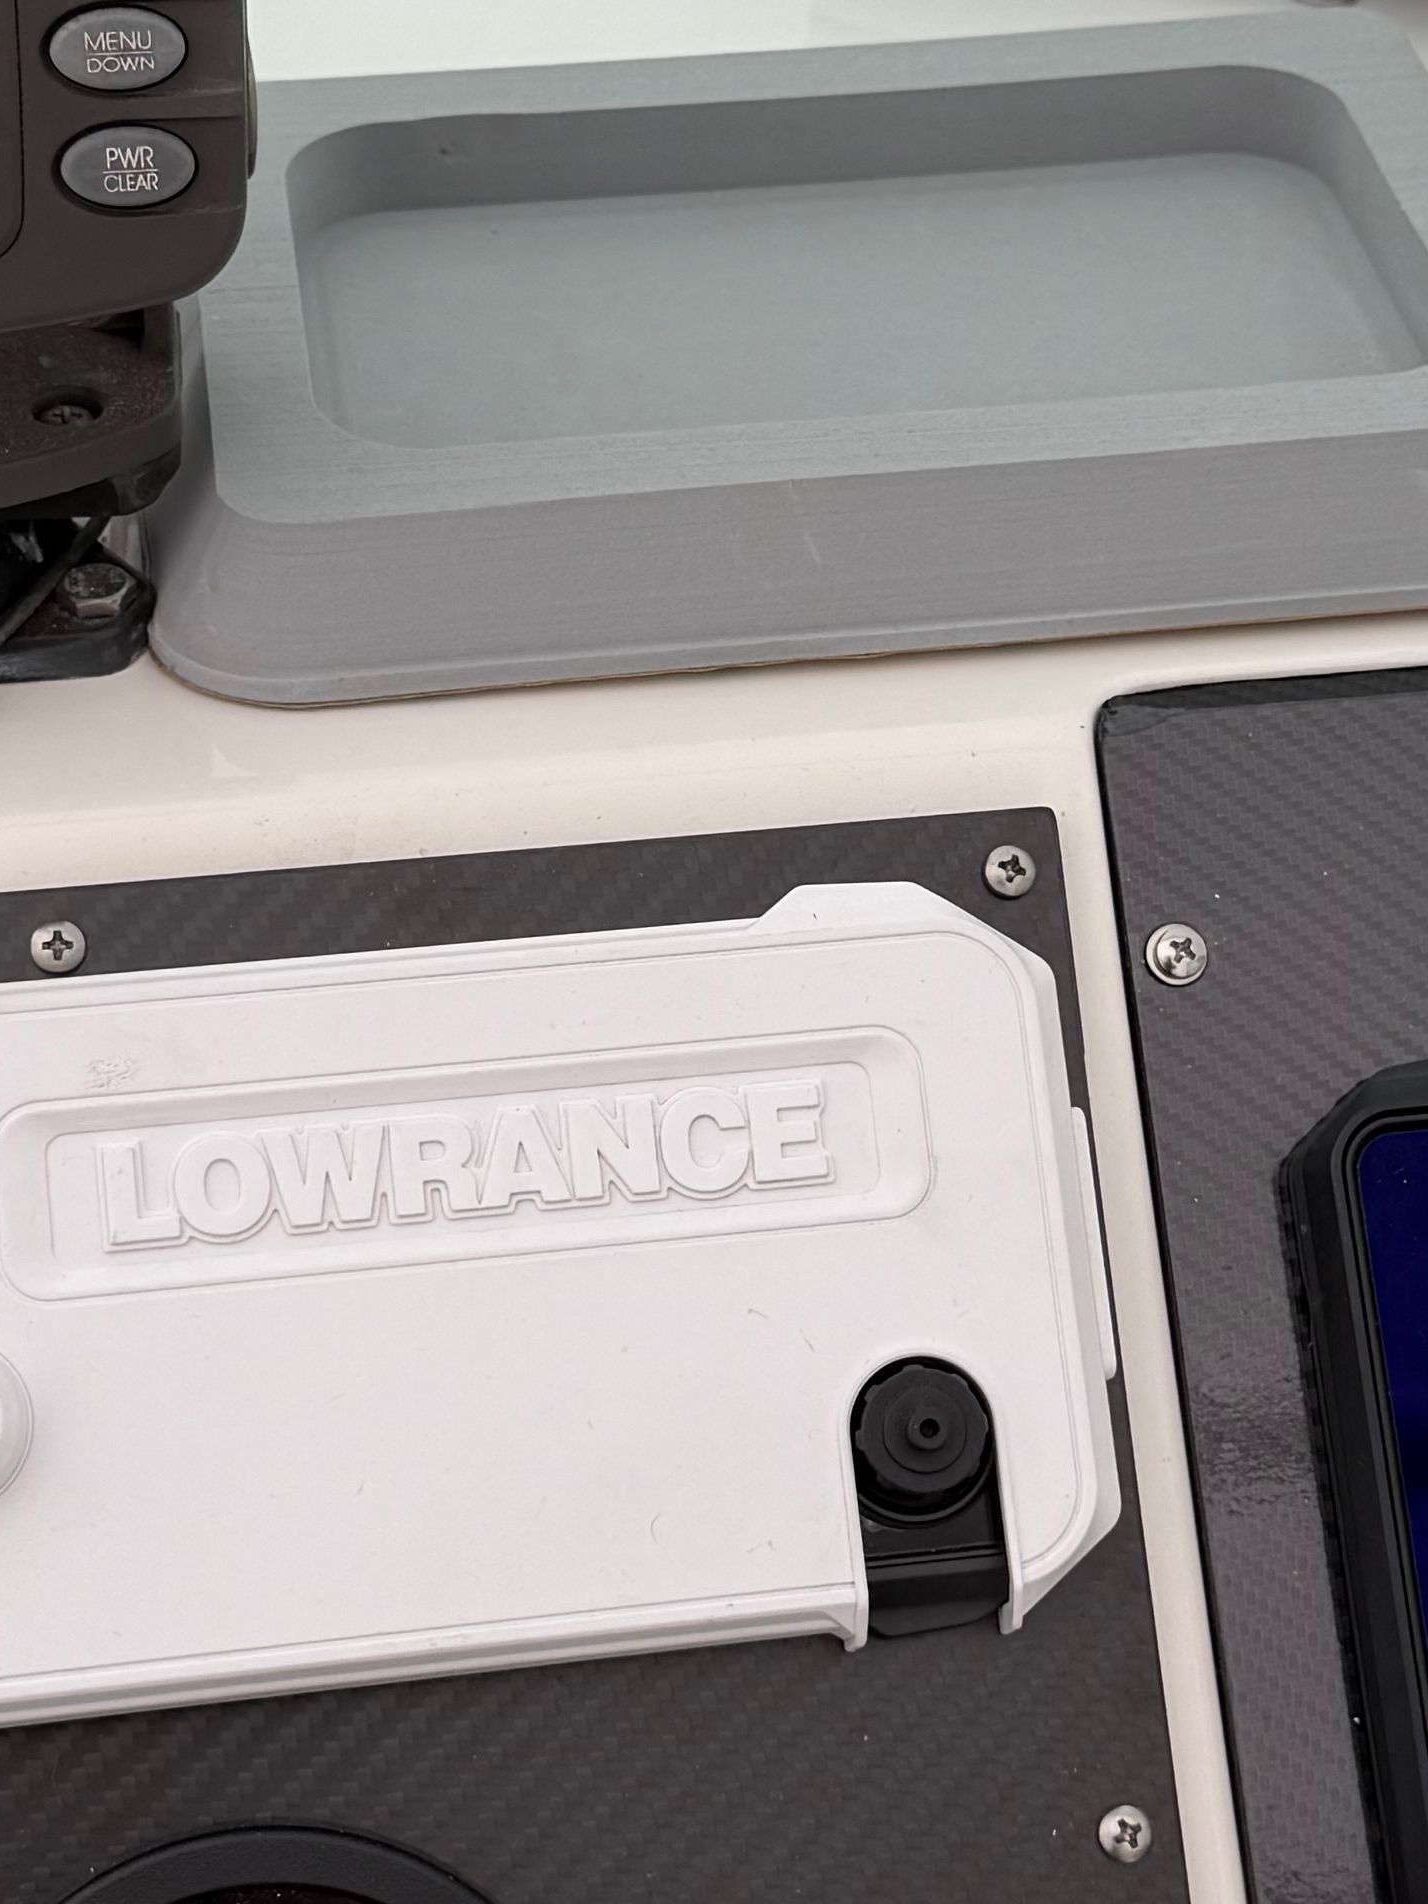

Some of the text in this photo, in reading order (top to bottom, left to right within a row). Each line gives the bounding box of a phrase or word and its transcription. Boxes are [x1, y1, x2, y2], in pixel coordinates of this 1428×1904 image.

[84, 30, 152, 52] MENU
[87, 56, 155, 73] DOWN
[106, 146, 154, 169] PWR
[104, 173, 159, 192] CLEAR
[95, 1079, 835, 1253] LOWRANCE
